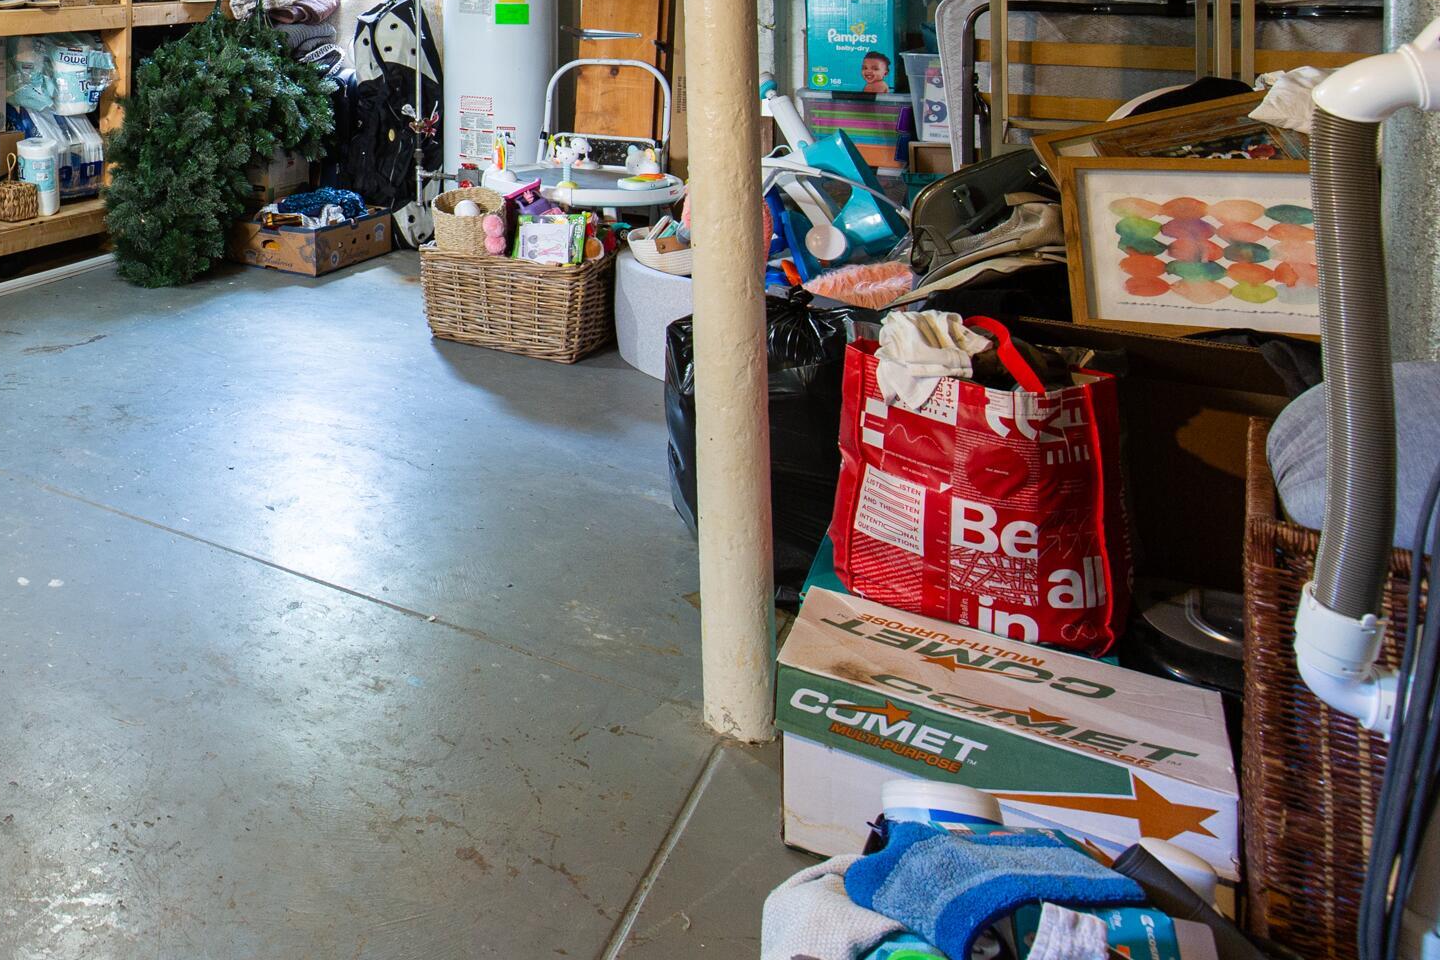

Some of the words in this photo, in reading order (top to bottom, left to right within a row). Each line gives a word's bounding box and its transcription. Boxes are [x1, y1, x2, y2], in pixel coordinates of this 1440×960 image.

[827, 28, 878, 44] Pampers
[835, 44, 870, 53] baby-dry
[863, 495, 877, 506] AND
[950, 496, 1039, 560] Be
[1047, 555, 1105, 609] all
[856, 612, 1046, 669] MULTI-PURPOSE
[977, 595, 1039, 644] in
[820, 616, 1116, 700] COMET
[789, 687, 988, 757] COMET
[872, 673, 1200, 763] COMET
[828, 720, 964, 775] MULTI-PURPOSE
